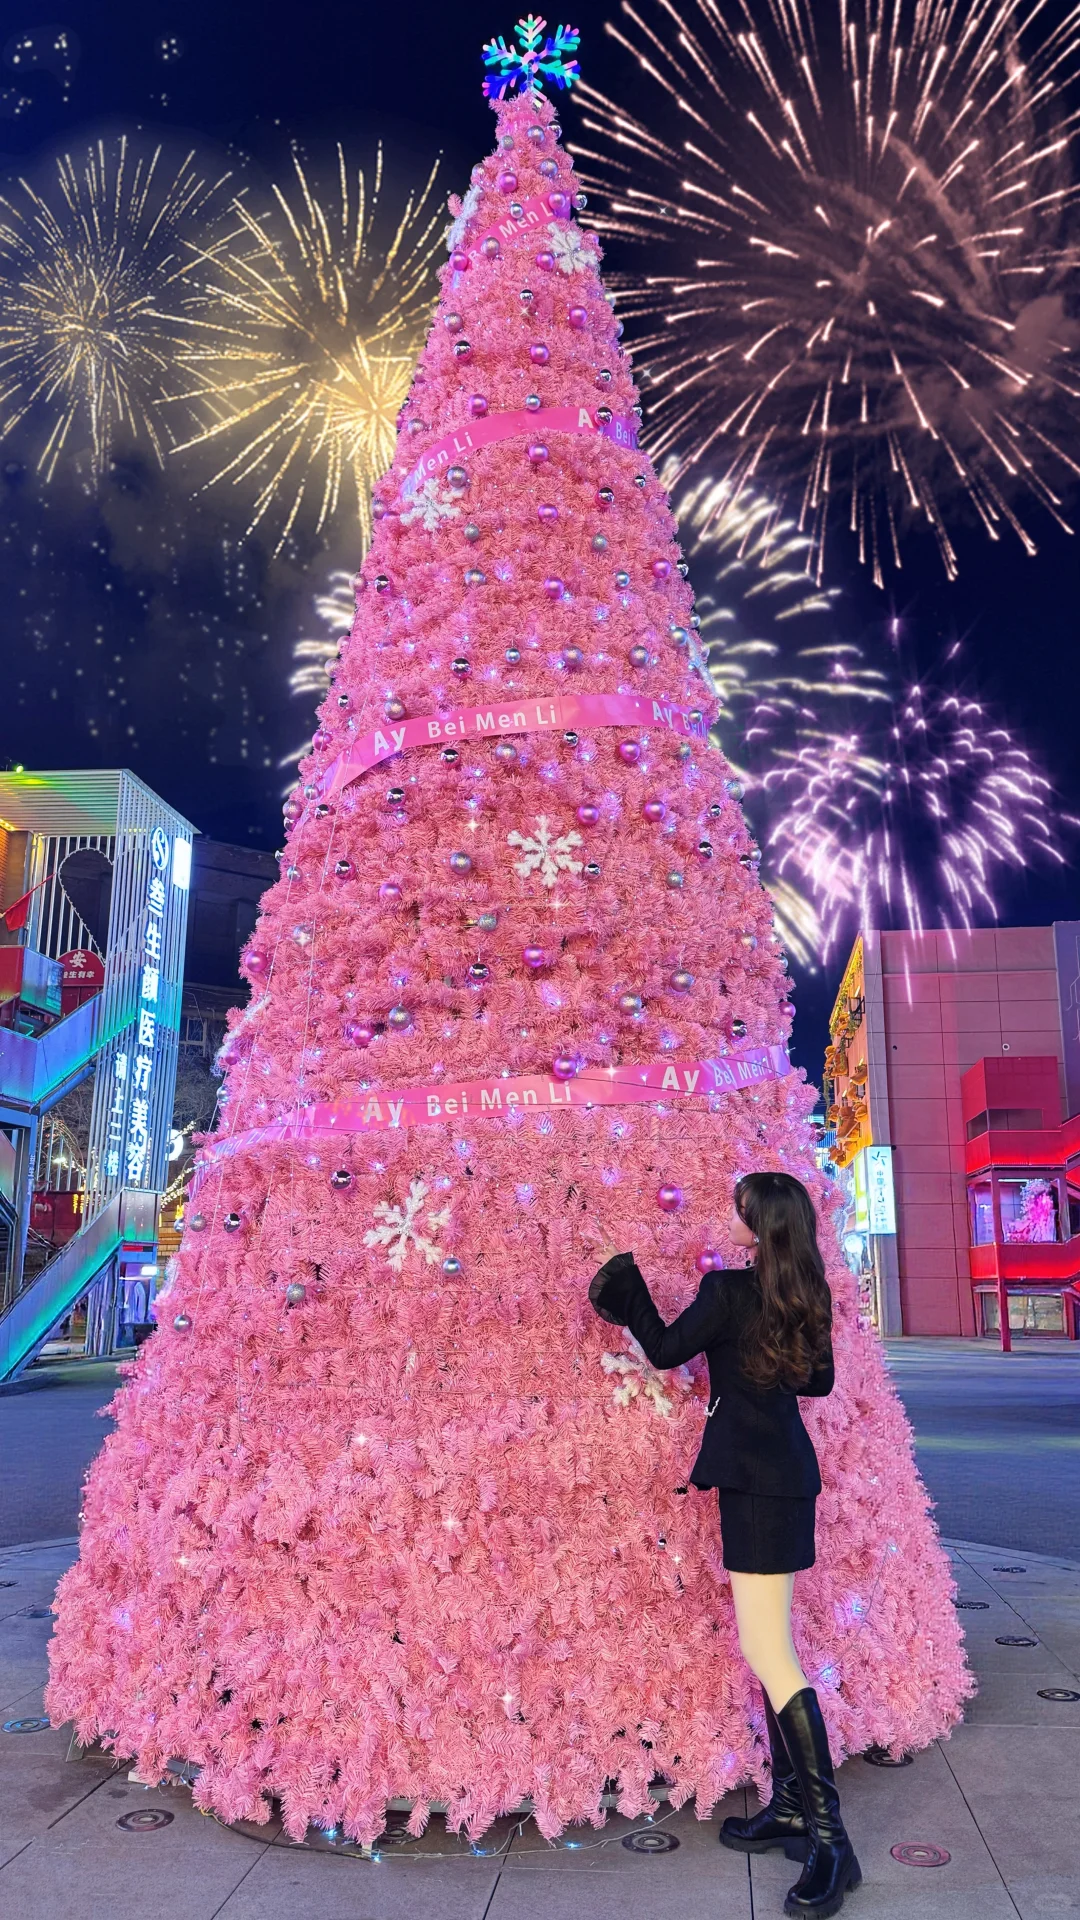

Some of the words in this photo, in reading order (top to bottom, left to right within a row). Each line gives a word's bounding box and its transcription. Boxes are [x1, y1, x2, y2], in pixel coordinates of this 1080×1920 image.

[499, 211, 540, 239] Men
[540, 201, 554, 217] L
[616, 421, 631, 446] Bei
[413, 449, 449, 484] Men
[454, 431, 474, 453] Li
[374, 726, 406, 756] Ay
[428, 715, 466, 739] Bei
[475, 710, 528, 732] Men
[536, 704, 558, 725] Li
[652, 701, 674, 729] Ay
[69, 950, 87, 969] 安
[661, 1066, 700, 1097] Ay
[713, 1065, 735, 1087] Bei
[737, 1060, 765, 1081] Men
[364, 1096, 405, 1126] Ay
[426, 1091, 468, 1117] Bei
[481, 1087, 538, 1112] Men
[547, 1081, 572, 1104] Li
